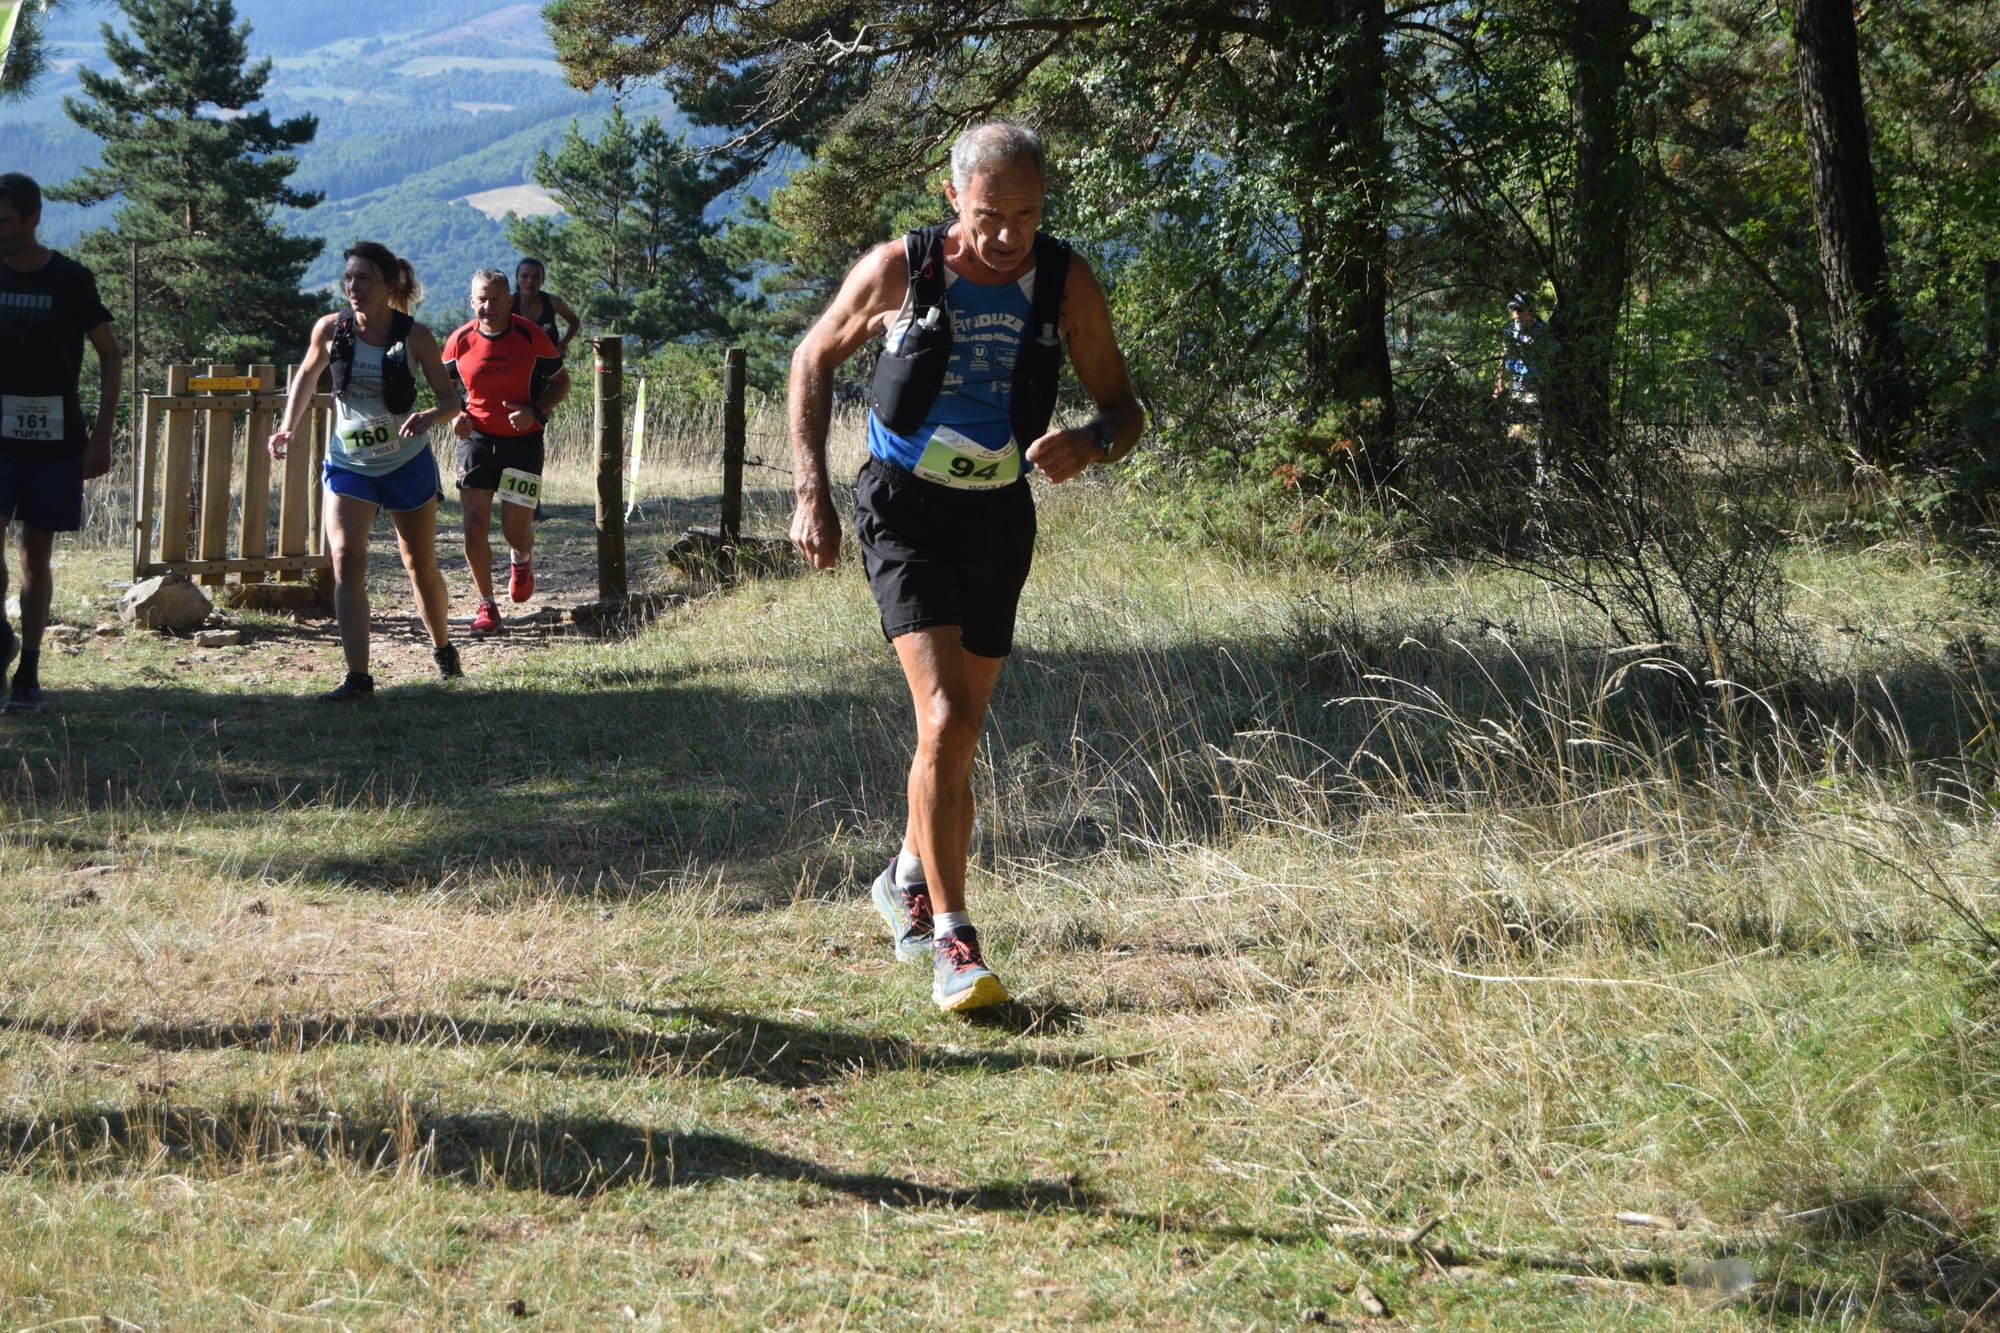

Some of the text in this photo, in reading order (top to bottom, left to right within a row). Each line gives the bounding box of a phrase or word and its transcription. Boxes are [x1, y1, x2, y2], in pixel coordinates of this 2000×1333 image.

[16, 414, 47, 429] 161
[350, 427, 389, 447] 160
[948, 456, 1000, 480] 94
[508, 477, 537, 497] 108
